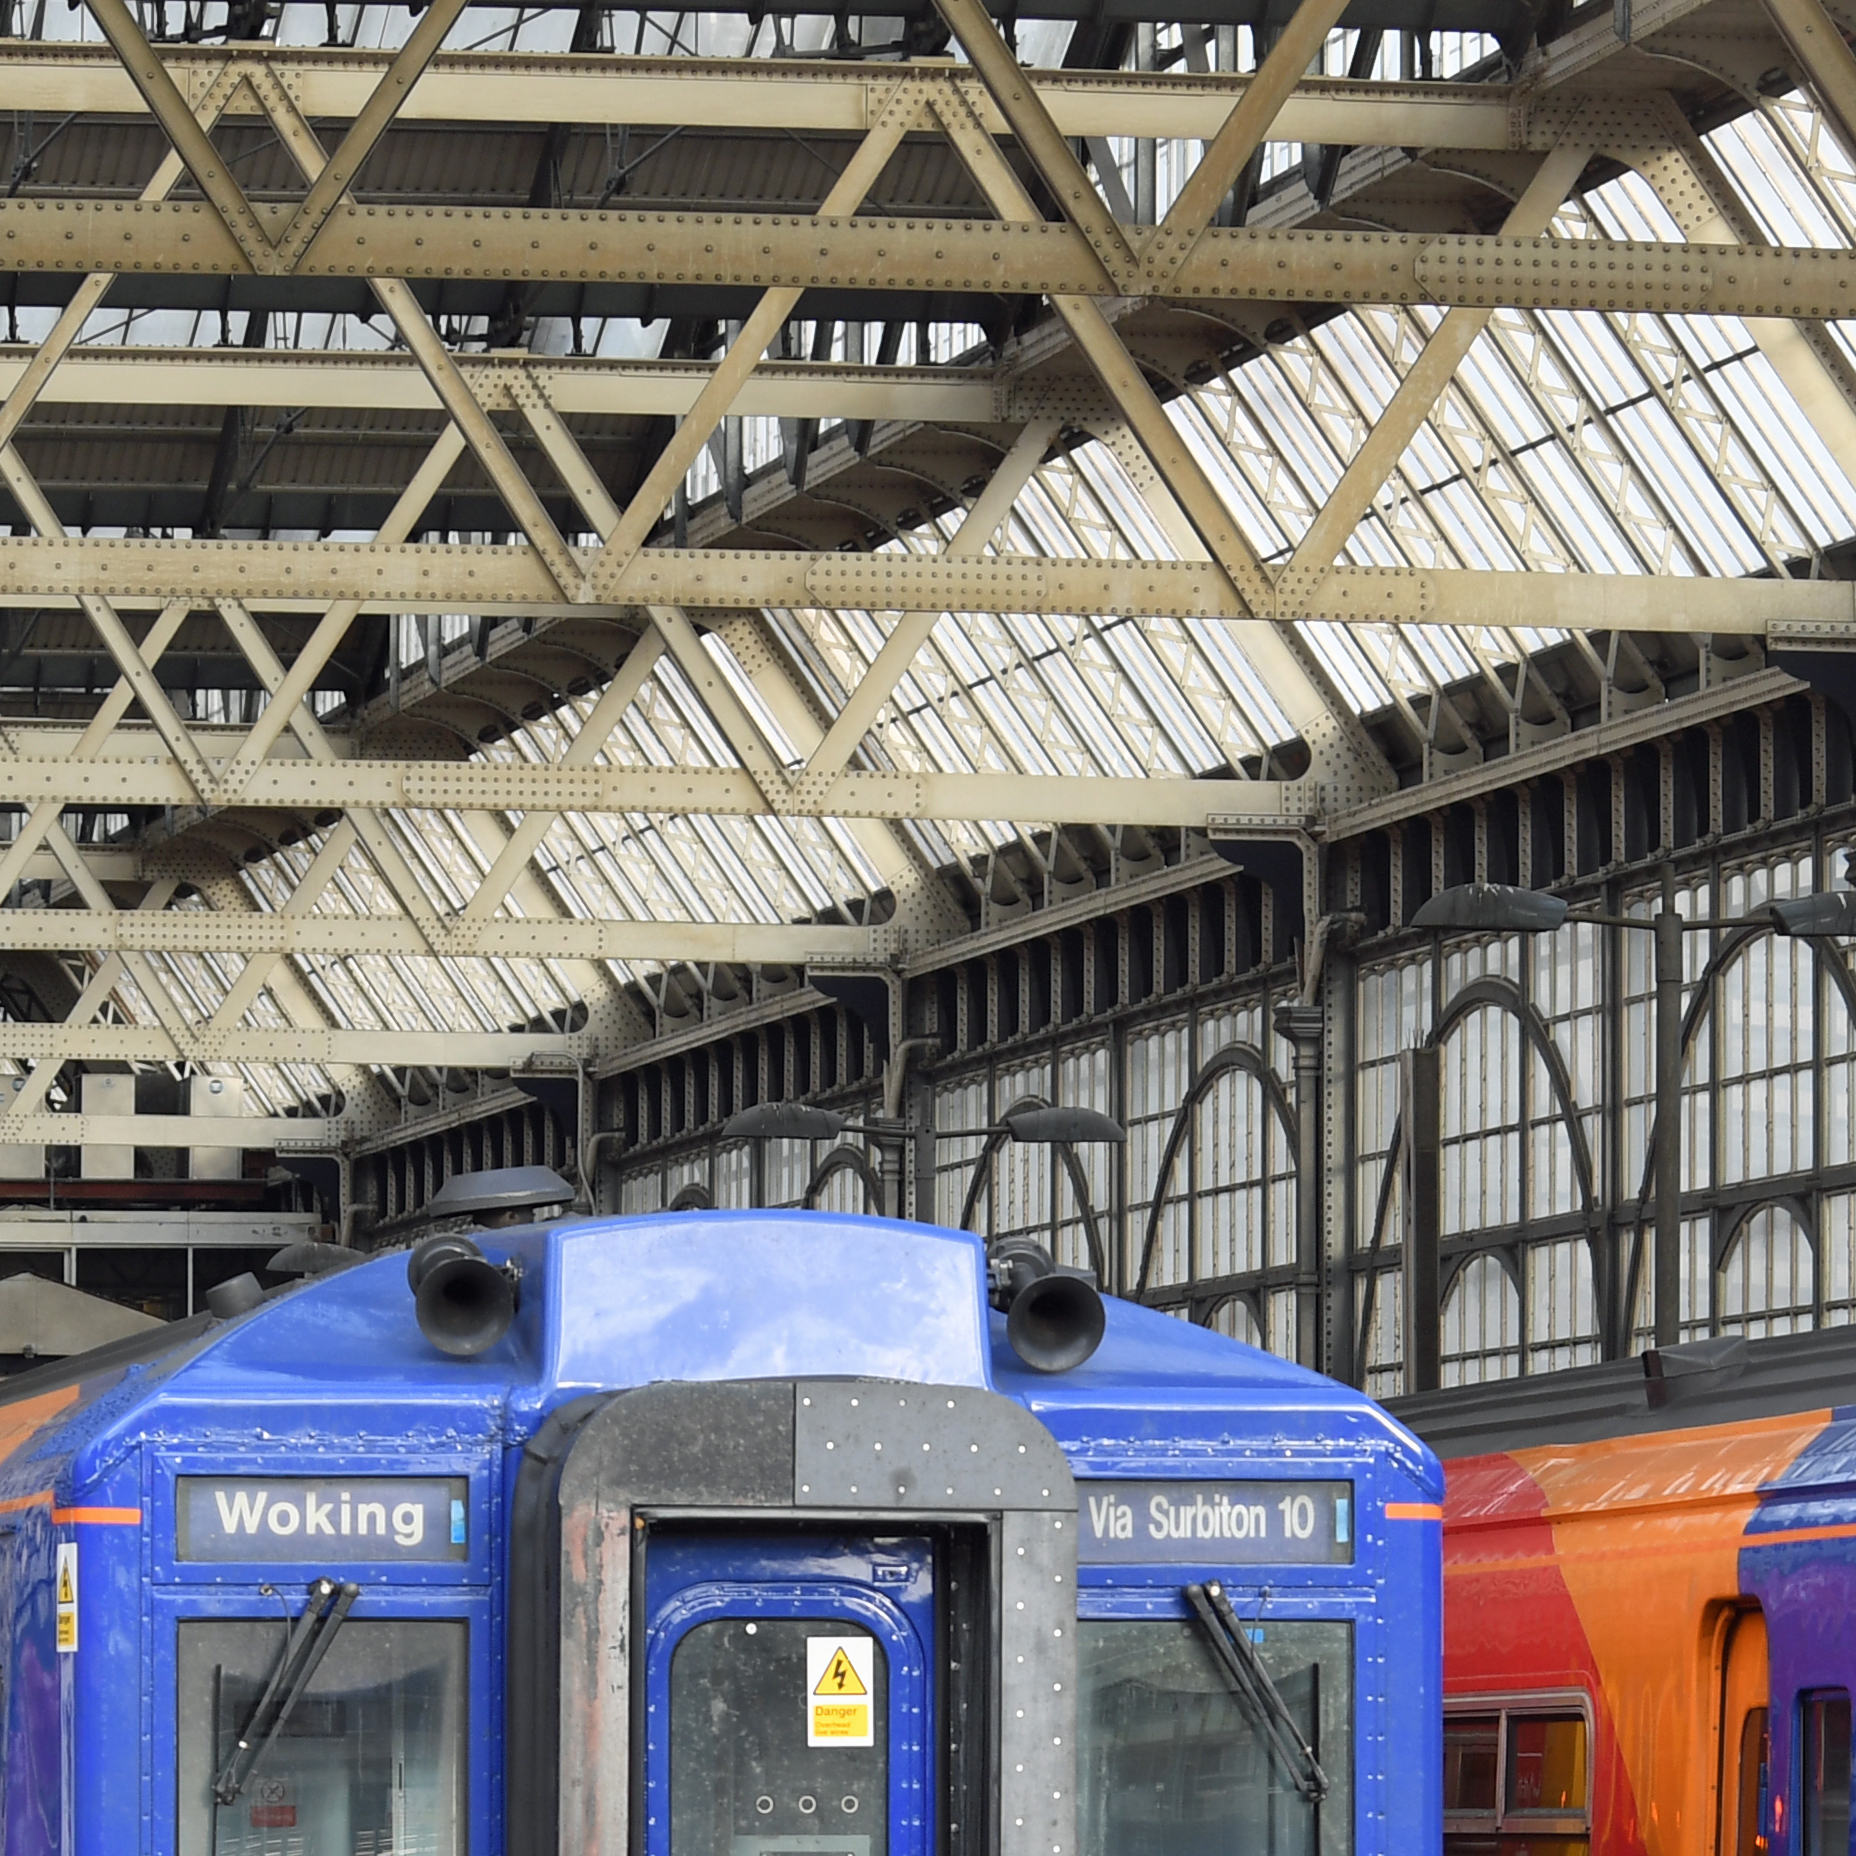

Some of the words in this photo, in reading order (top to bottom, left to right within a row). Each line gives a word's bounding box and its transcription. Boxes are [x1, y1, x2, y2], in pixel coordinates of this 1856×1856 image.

[215, 1491, 425, 1545] Woking
[1088, 1497, 1133, 1539] Via
[1148, 1495, 1266, 1540] Surbiton
[1278, 1496, 1315, 1539] 10
[815, 1706, 857, 1718] Danger
